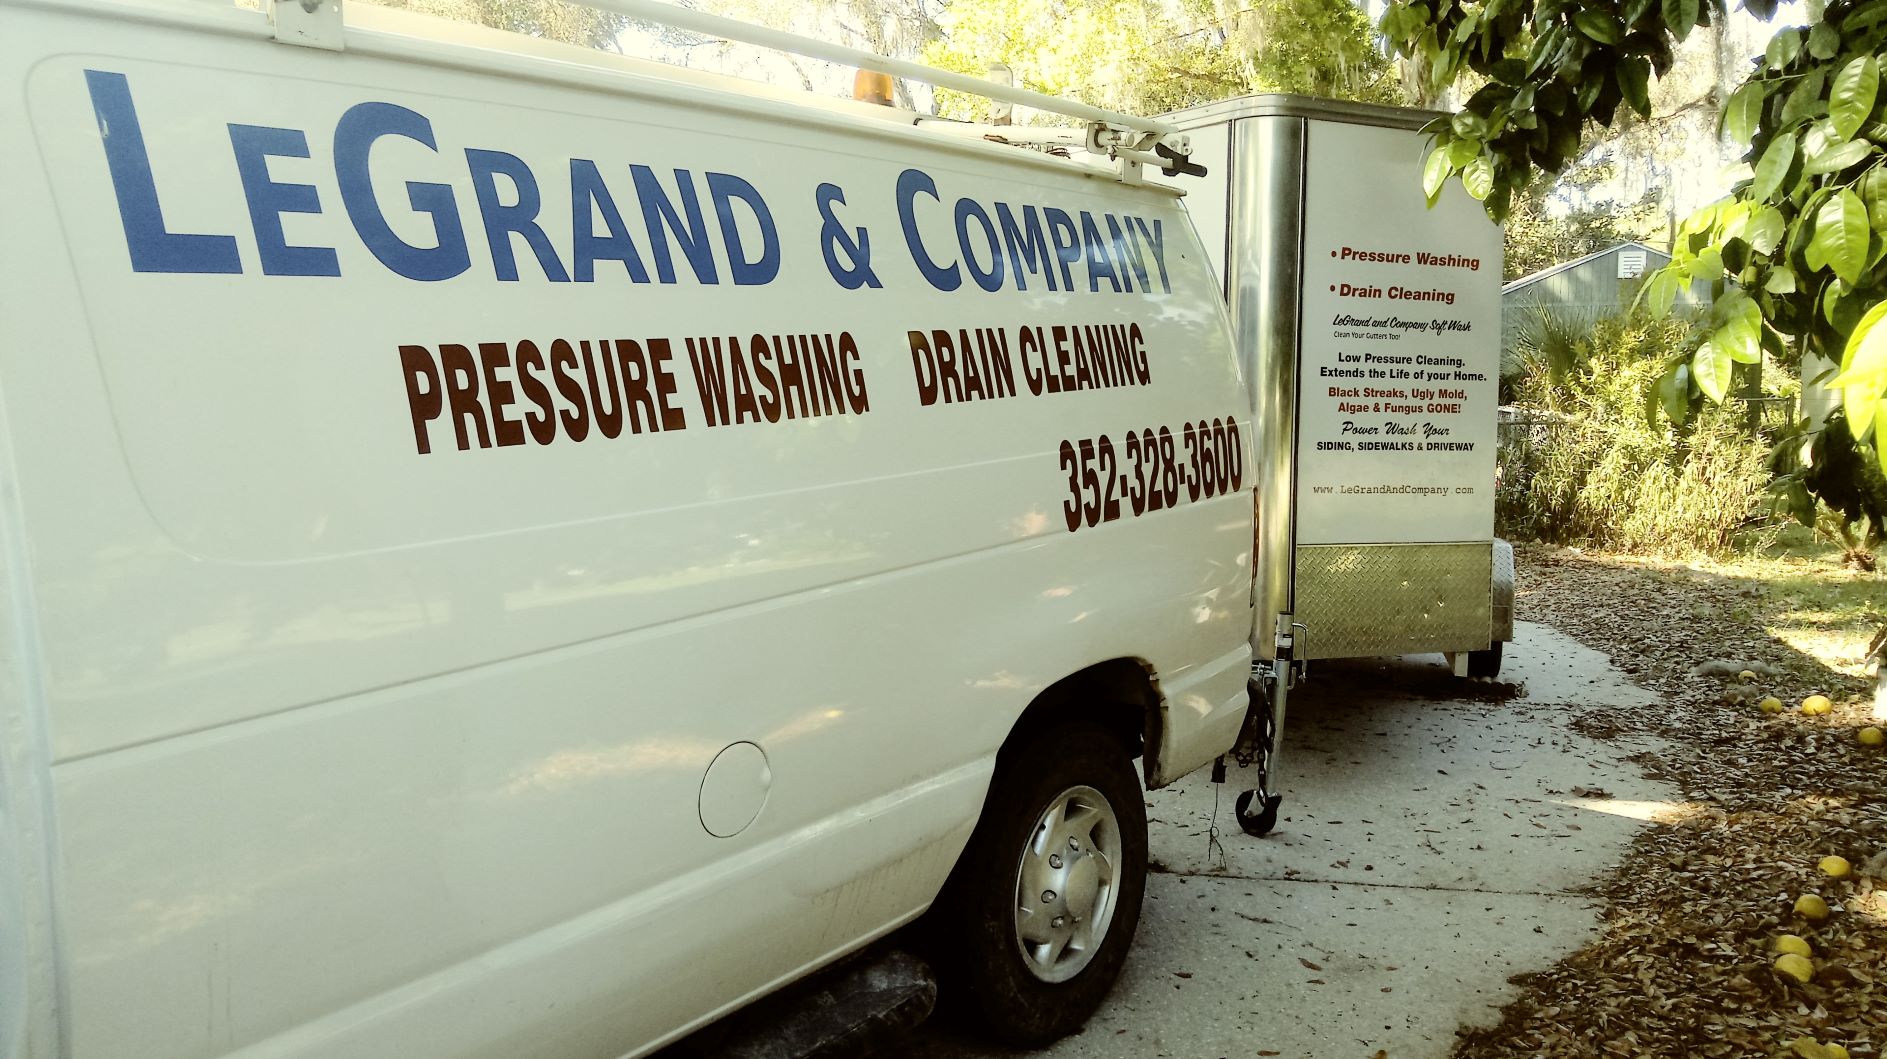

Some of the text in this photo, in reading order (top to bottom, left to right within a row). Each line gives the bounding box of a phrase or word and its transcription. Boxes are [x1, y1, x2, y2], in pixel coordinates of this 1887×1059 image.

[815, 182, 884, 290] &
[1340, 247, 1480, 271] Pressure Washing
[1339, 283, 1455, 305] Drain Cleaning
[1333, 313, 1472, 336] LeGrand and Company Soft Wash
[1334, 331, 1401, 341] Clean Your Gutters Too!
[1338, 352, 1466, 367] Low Pressure Cleaning.
[1320, 367, 1487, 382] Extends the Life of your Home.
[398, 321, 1152, 455] PRESSURE WASHING DRAIN CLEANING
[1328, 387, 1468, 401] Black Streaks, Ugly Mold,
[1338, 403, 1461, 415] Algae & Fungus GONE!
[1341, 421, 1450, 438] Power Wash Your
[1317, 442, 1475, 452] SIDING, SIDEWALKS & DRIVEWAY
[1059, 414, 1242, 532] 352-328-3600
